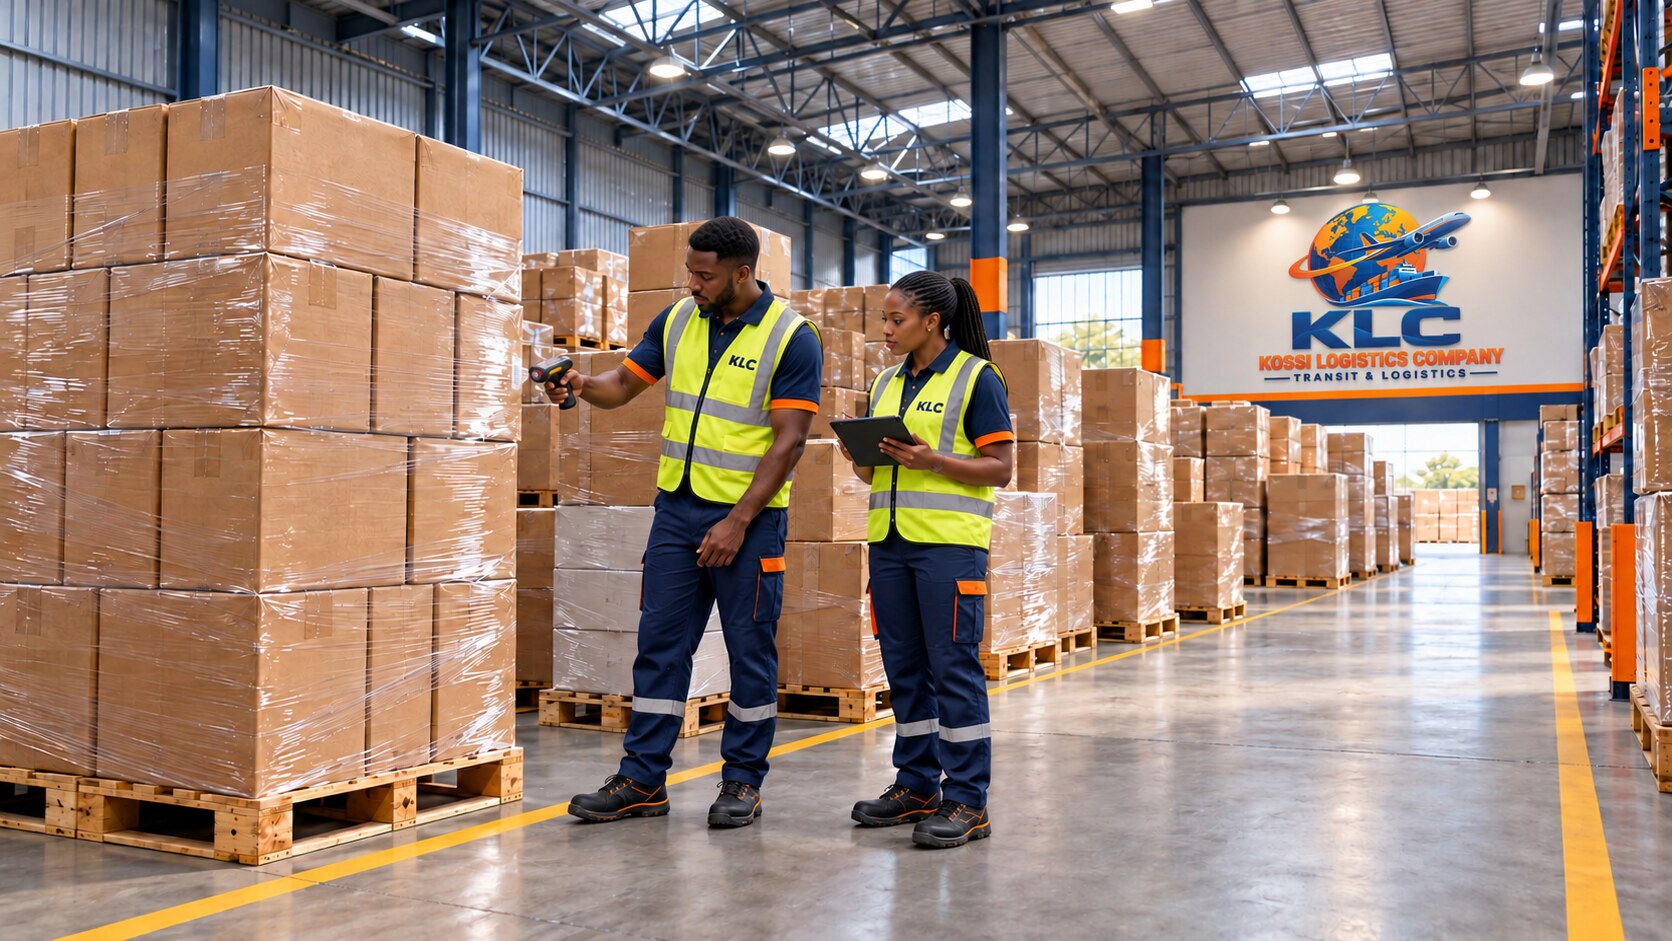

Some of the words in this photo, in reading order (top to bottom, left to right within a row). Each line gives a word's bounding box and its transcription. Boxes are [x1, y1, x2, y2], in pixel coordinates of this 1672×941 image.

[1291, 306, 1461, 350] KLC
[728, 354, 757, 371] KLC
[1259, 354, 1312, 371] KOSSI
[1316, 351, 1408, 369] LOGISTICS
[1413, 347, 1504, 367] COMPANY
[1294, 371, 1358, 382] TRANSIT
[1365, 371, 1374, 381] &
[1382, 368, 1466, 380] LOGISTICS
[916, 400, 944, 413] KLC
